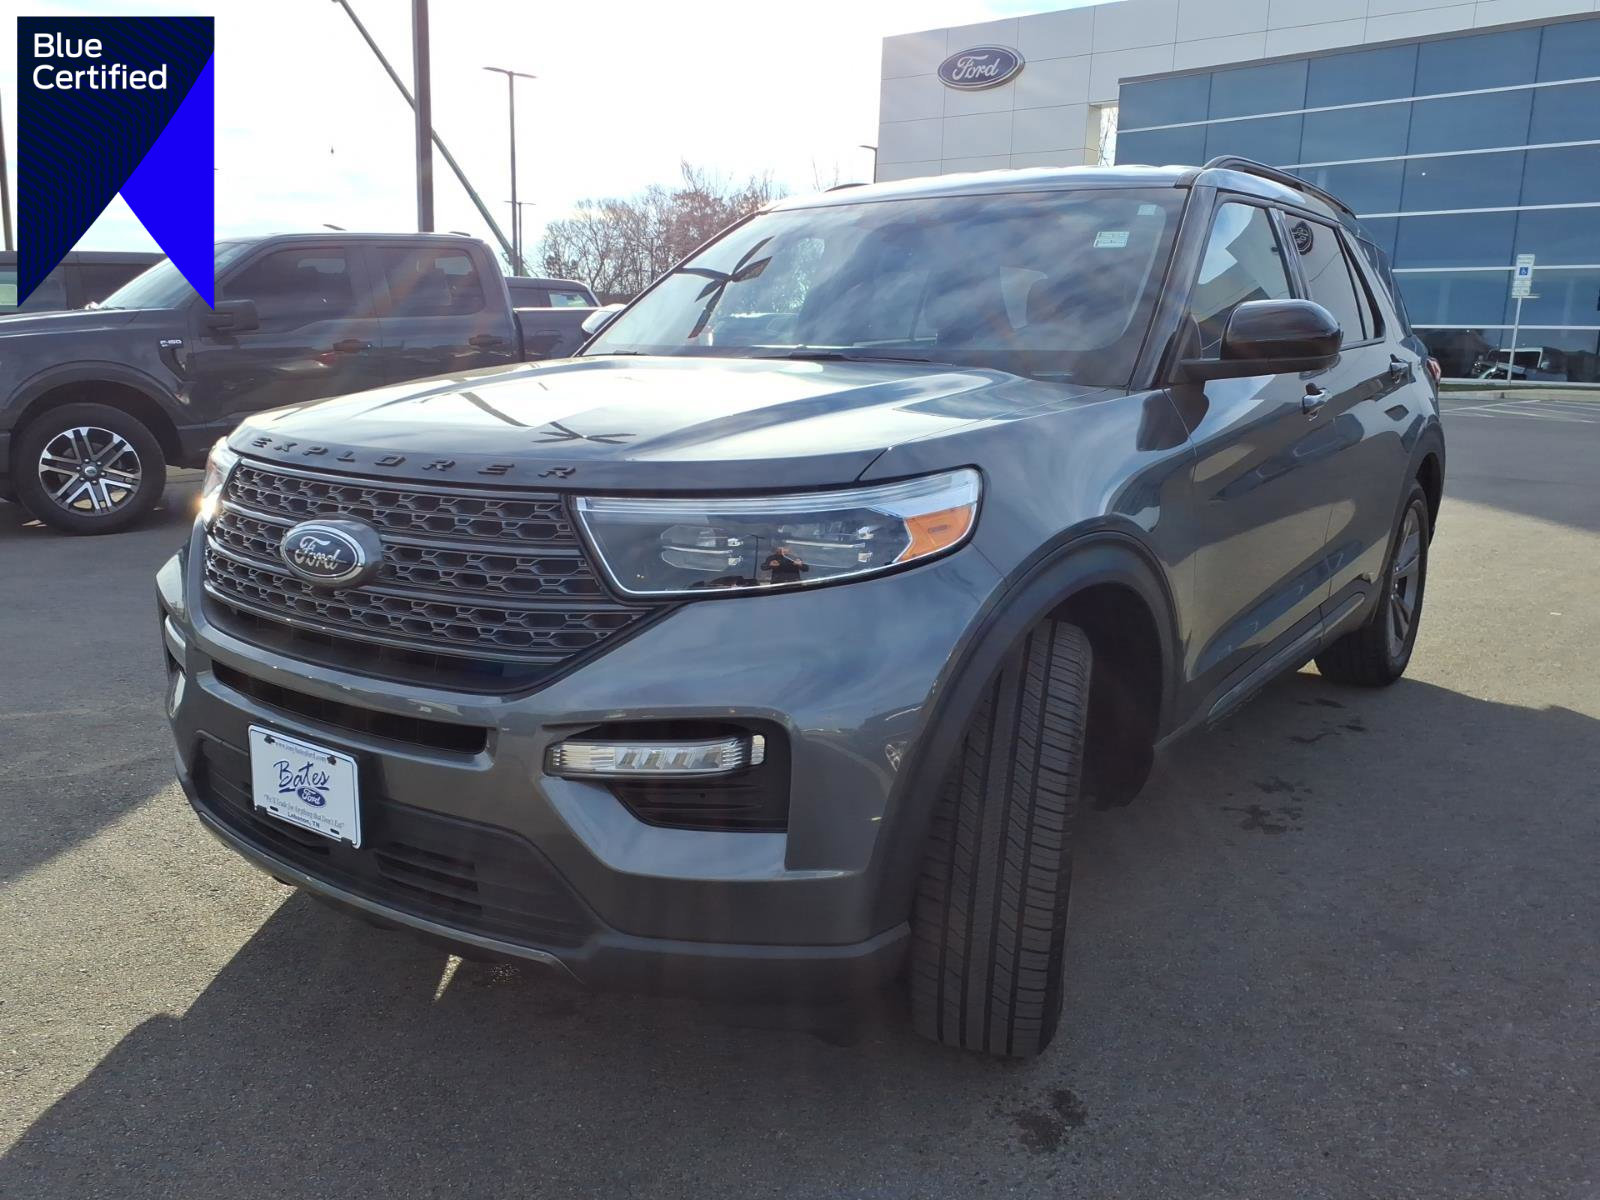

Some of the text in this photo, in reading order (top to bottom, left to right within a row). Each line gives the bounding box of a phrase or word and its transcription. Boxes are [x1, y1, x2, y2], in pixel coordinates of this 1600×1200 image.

[952, 54, 1001, 81] Ford
[251, 437, 577, 479] EXPLORER
[294, 535, 348, 571] Ford
[272, 760, 330, 788] Bates
[301, 788, 321, 805] Ford
